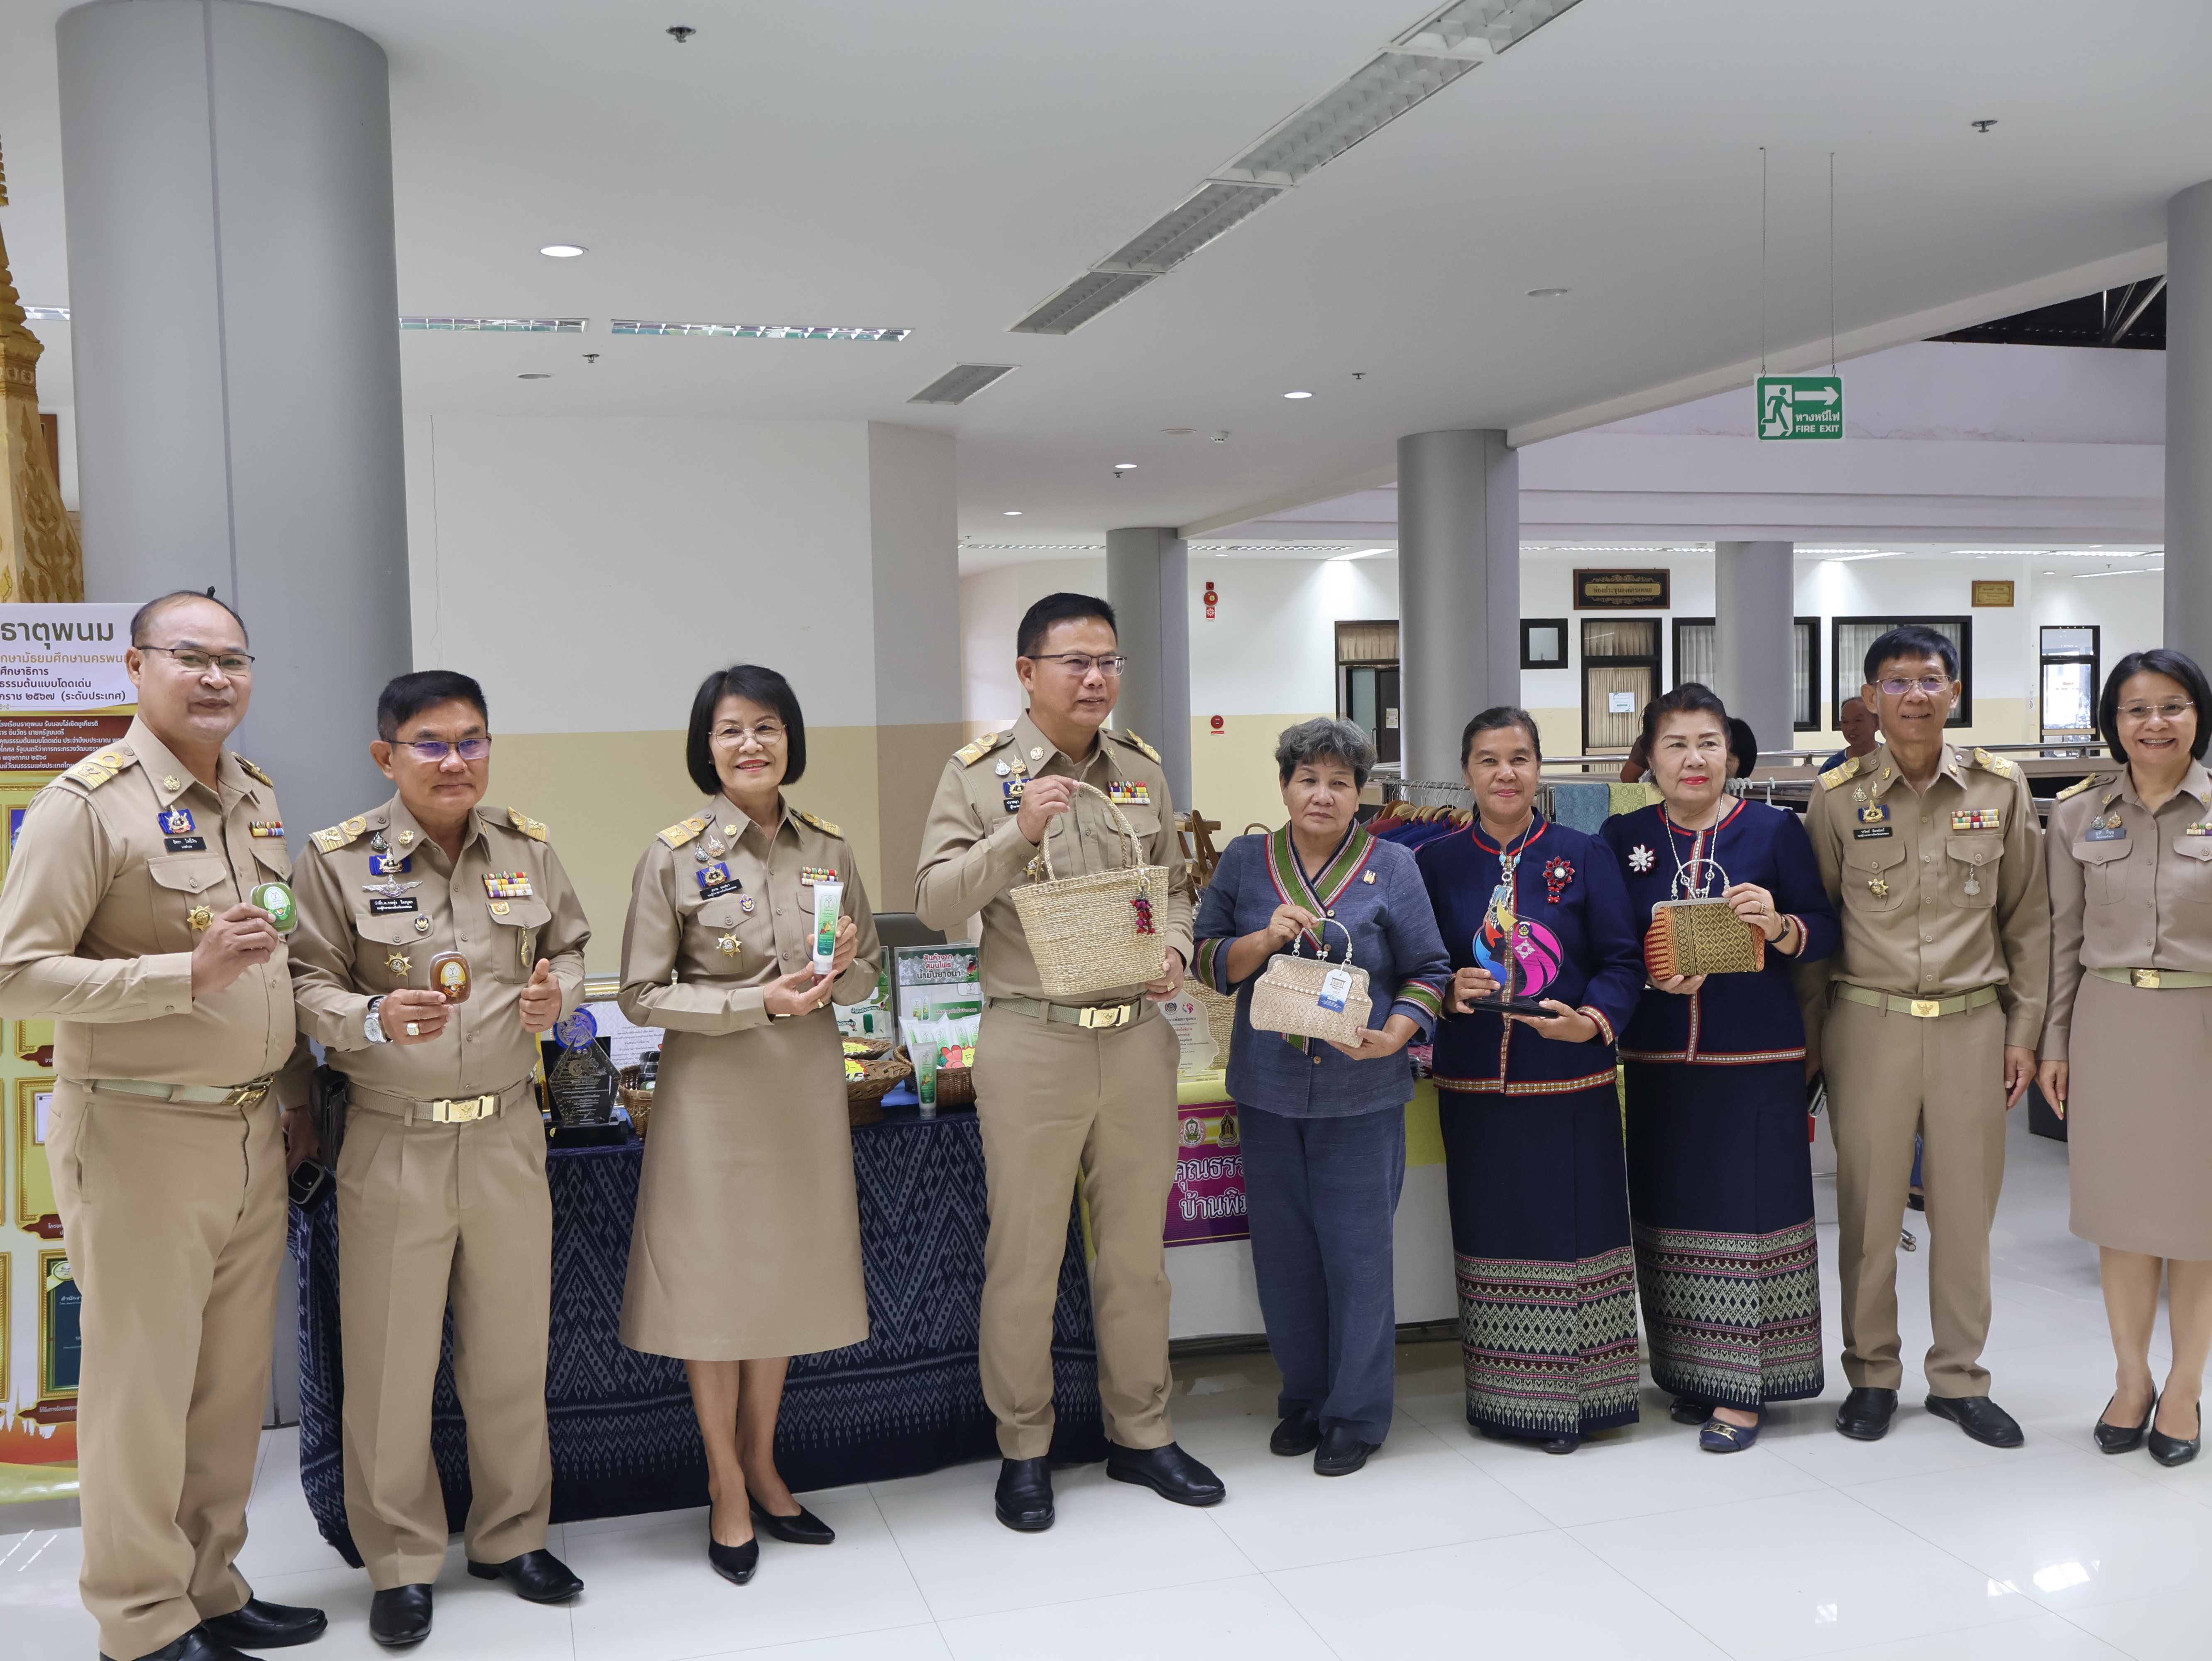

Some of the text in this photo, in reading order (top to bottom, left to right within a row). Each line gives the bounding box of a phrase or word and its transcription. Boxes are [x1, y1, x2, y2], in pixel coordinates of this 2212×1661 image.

[1796, 409, 1840, 421] ทางหนีไฟ
[1, 622, 113, 650] ธาตุพนม
[1, 652, 126, 663] กษามัธยมศึกษานครพน
[0, 666, 49, 675] ศึกษาธิการ
[0, 678, 91, 688] ธรรมต้นแบบโดดเด่น
[61, 691, 126, 702] (ระดับประเทศ)
[926, 961, 951, 970] สมุนไพร
[917, 969, 961, 979] น้ำมันยางนา
[965, 1053, 975, 1066] 5
